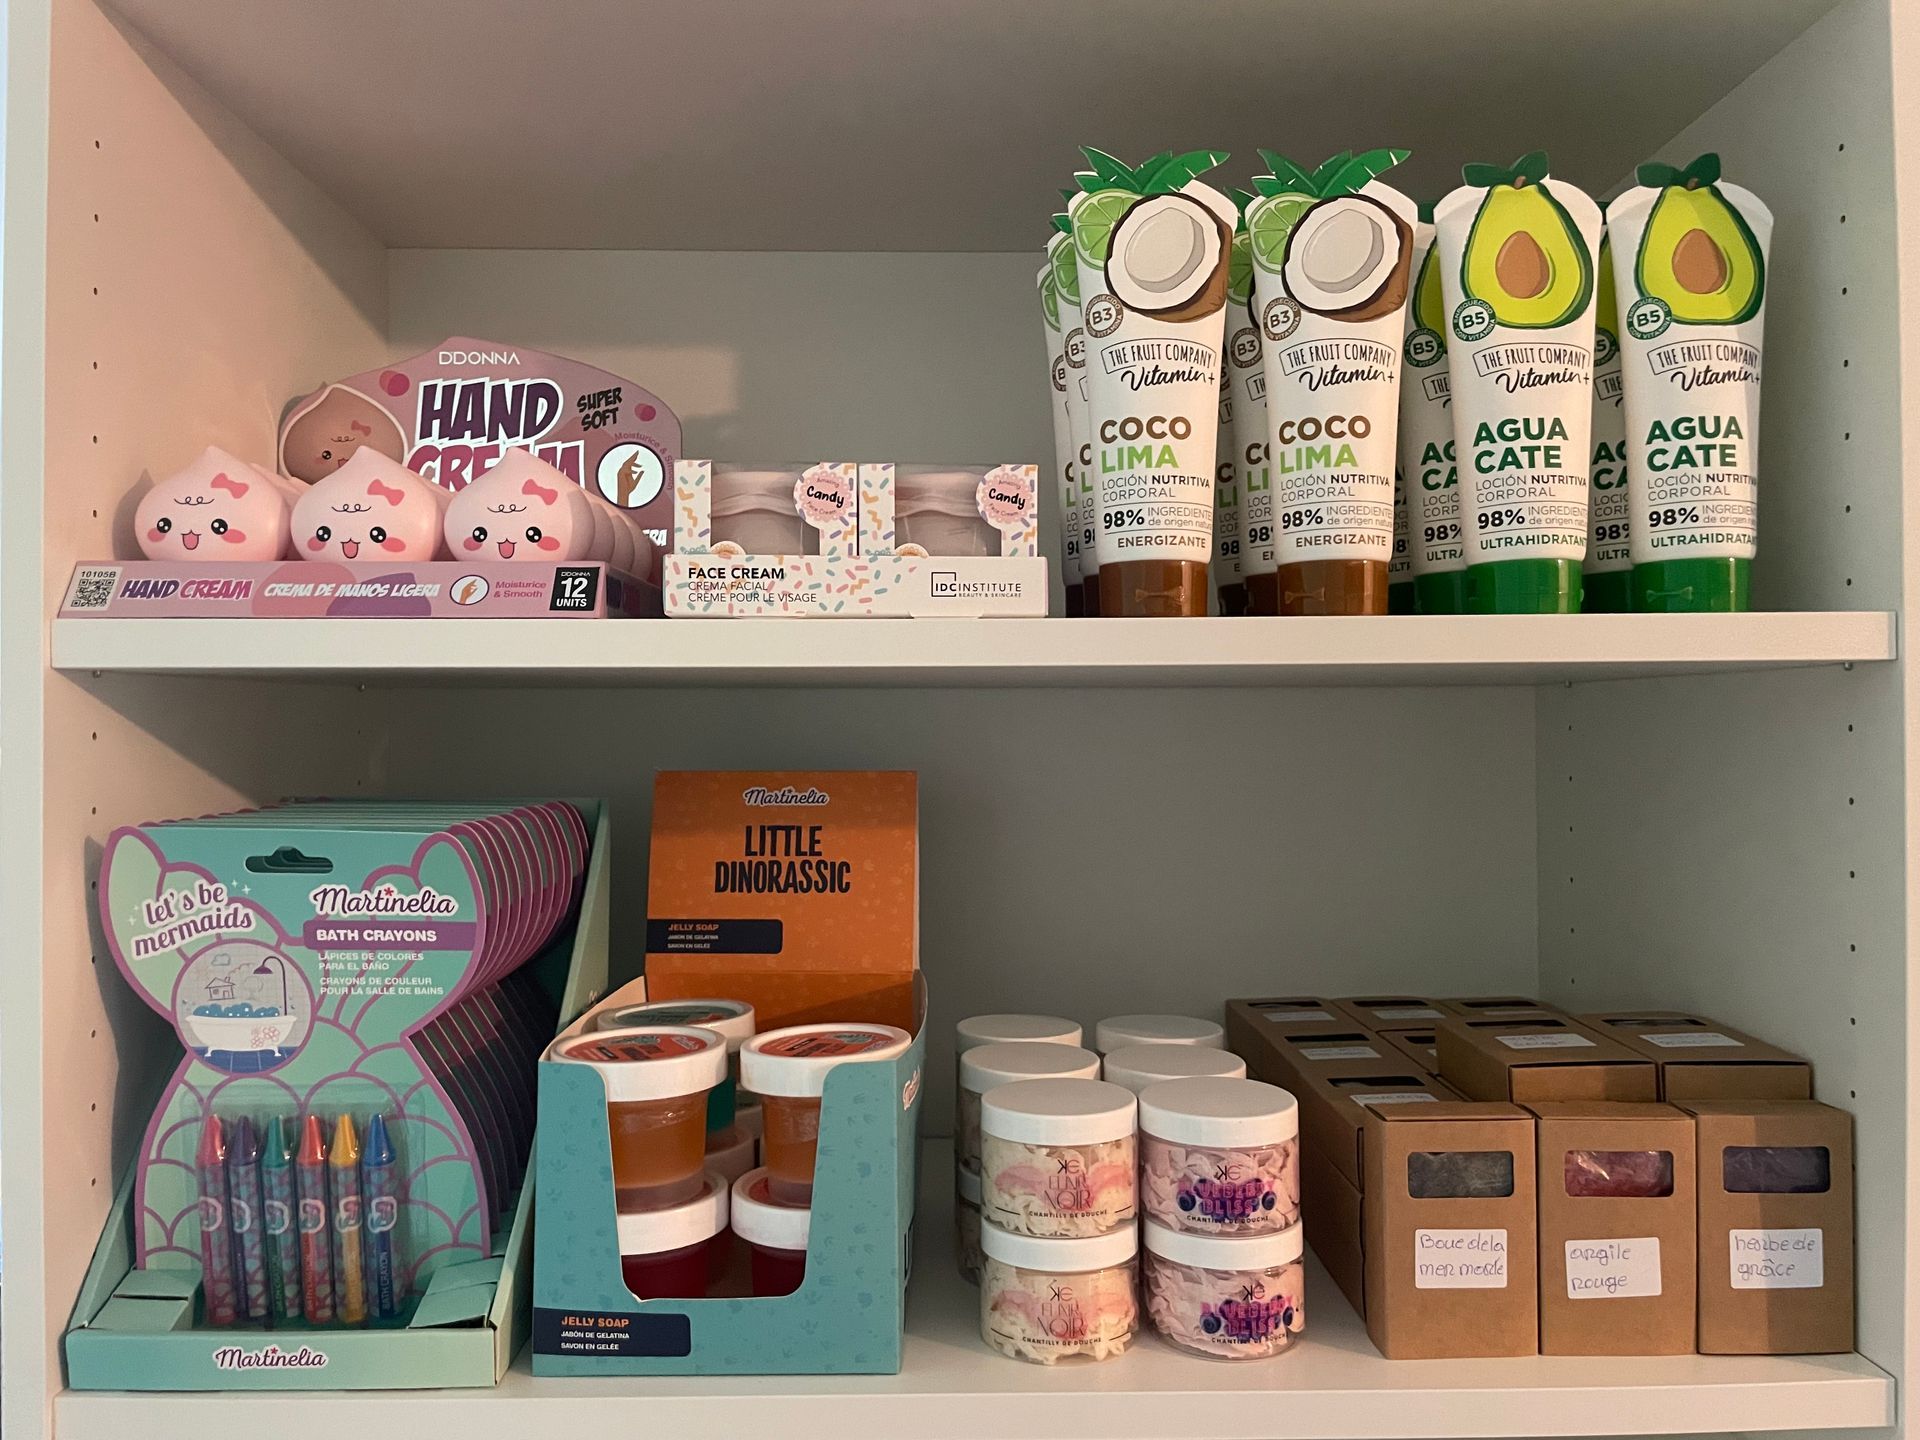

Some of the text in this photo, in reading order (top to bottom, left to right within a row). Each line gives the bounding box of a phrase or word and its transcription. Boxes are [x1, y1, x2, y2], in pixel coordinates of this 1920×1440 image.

[1092, 307, 1113, 325] B3
[1270, 310, 1290, 328] B3
[1462, 312, 1485, 329] B5
[1636, 309, 1661, 327] B5
[1109, 345, 1129, 366] THE
[1131, 343, 1161, 361] FRUIT
[1165, 344, 1212, 368] COMPANY
[1237, 343, 1256, 357] B3
[1287, 348, 1306, 368] THE
[1309, 343, 1340, 362] FRUIT
[1344, 344, 1391, 368] COMPANY
[1413, 341, 1435, 354] B5
[1657, 344, 1758, 369] THE FRUIT COMPANY
[1482, 347, 1586, 370] THE FRUIT COMPANY
[577, 387, 622, 413] SUPER
[418, 380, 560, 444] HAND
[581, 407, 619, 431] SOFT
[1100, 416, 1191, 444] COCO
[1279, 415, 1371, 445] COCO
[1473, 417, 1568, 448] AGUA
[1645, 415, 1744, 445] AGUA
[1101, 444, 1179, 474] LIMA
[1280, 443, 1358, 474] LIMA
[1474, 445, 1562, 474] CATE
[1647, 444, 1737, 473] CATE
[1103, 474, 1210, 490] LOCIÓN NUTRITIVA
[1281, 474, 1390, 491] LOCIÓN NUTRITIVA
[1476, 474, 1586, 491] LOCIÓN NUTRITIVA
[1647, 472, 1701, 489] LOCIÓN
[807, 486, 844, 508] Candy
[989, 488, 1025, 510] Candy
[1103, 488, 1176, 502] CORPORAL
[1281, 486, 1356, 503] CORPORAL
[1477, 487, 1556, 503] CORPORAL
[1648, 486, 1731, 501] CORPORAL
[1104, 507, 1212, 529] 98% INGREDIENTE
[1148, 518, 1193, 528] de origen
[1282, 508, 1323, 529] 98%
[1326, 505, 1392, 520] INGREDIENTE
[1327, 517, 1373, 527] de origen
[1478, 508, 1525, 530] 98%
[1529, 517, 1542, 525] de
[1545, 517, 1573, 527] origen
[1649, 507, 1699, 527] 98%
[1720, 516, 1747, 525] origen
[1118, 535, 1206, 549] ENERGIZANTE
[1296, 534, 1386, 547] ENERGIZANTE
[81, 570, 116, 579] 10105B
[688, 568, 785, 579] FACE CREAM
[119, 580, 253, 600] HAND CREAM
[264, 583, 441, 598] CREMA DE MANOS LIGERA
[493, 590, 542, 598] & Smooth
[495, 581, 546, 589] Moisturice
[560, 577, 589, 598] 12
[688, 581, 768, 591] CREMA FACIAL
[556, 598, 587, 607] UNITS
[730, 593, 760, 602] POUR
[763, 593, 774, 602] LE
[778, 593, 816, 602] VISAGE
[745, 789, 827, 805] Martinelia
[745, 825, 822, 856] LITTLE
[715, 860, 850, 893] DINORASSIC
[199, 884, 224, 905] be
[313, 887, 455, 914] Martinelia
[135, 907, 252, 956] mermaids
[316, 929, 437, 942] BATH CRAYONS
[362, 961, 389, 970] BAÑO
[377, 953, 424, 961] COLORES
[320, 977, 366, 985] CRAYONS
[320, 987, 444, 995] POUR LA SALLE DE BAINS
[1420, 1234, 1464, 1249] Boue
[1793, 1233, 1816, 1251] de
[1570, 1243, 1631, 1266] argile
[562, 1316, 629, 1327] JELLY SOAP
[215, 1347, 326, 1368] Martinelia
